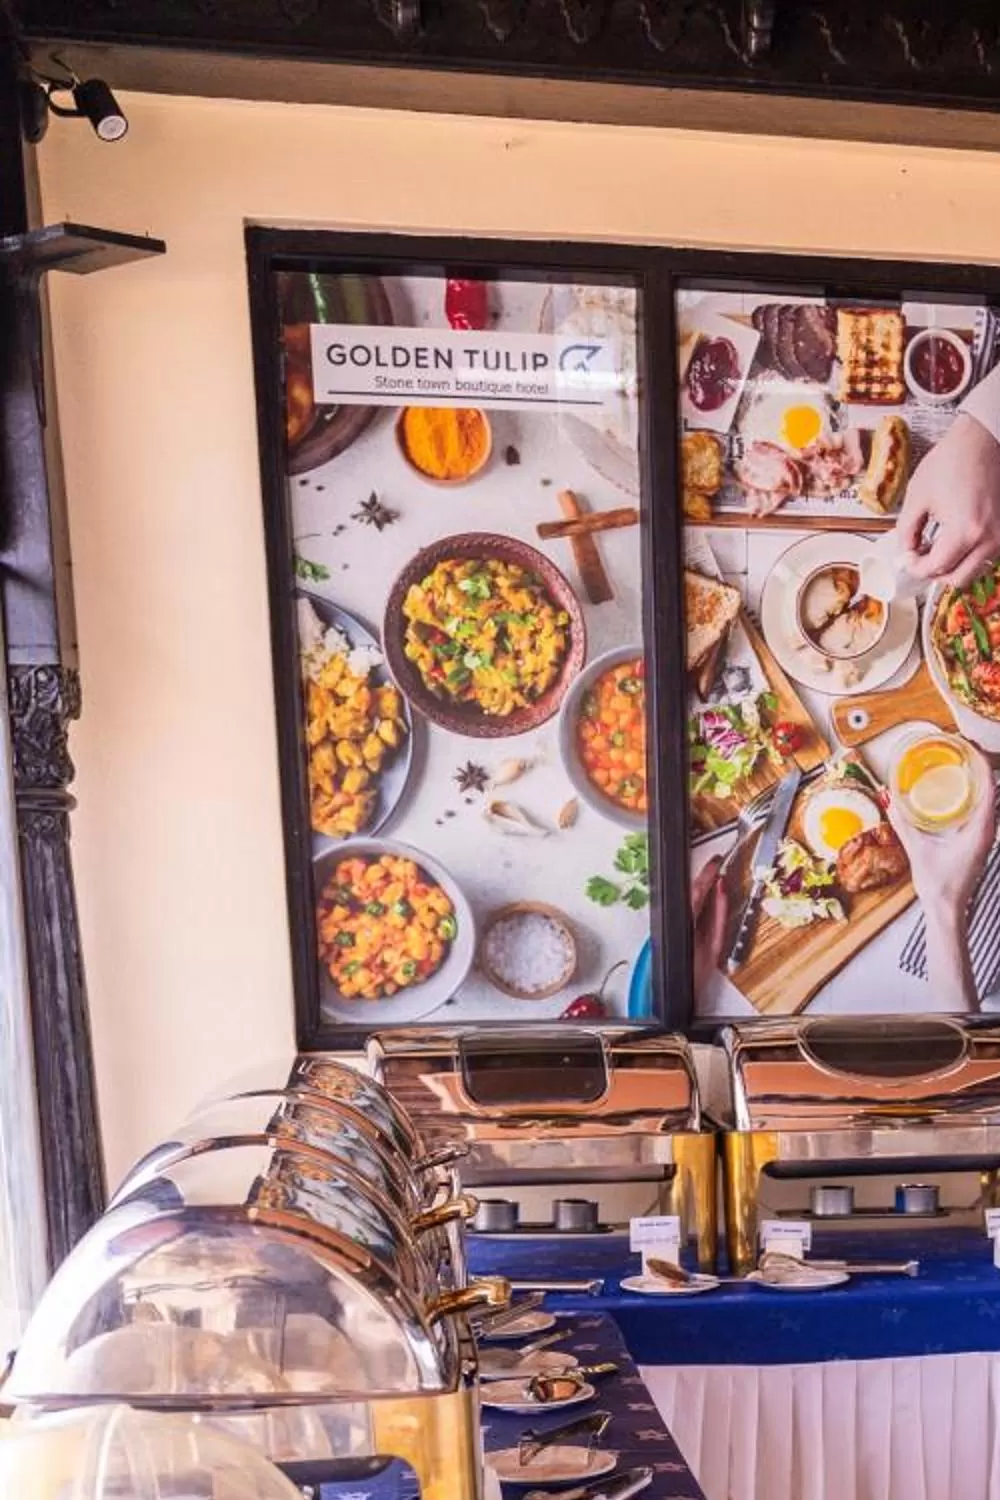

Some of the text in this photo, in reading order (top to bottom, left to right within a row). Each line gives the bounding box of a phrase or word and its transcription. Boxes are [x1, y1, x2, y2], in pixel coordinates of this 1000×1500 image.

[326, 343, 549, 372] GOLDEN TULIP
[375, 375, 549, 395] Stone town boutique hotel
